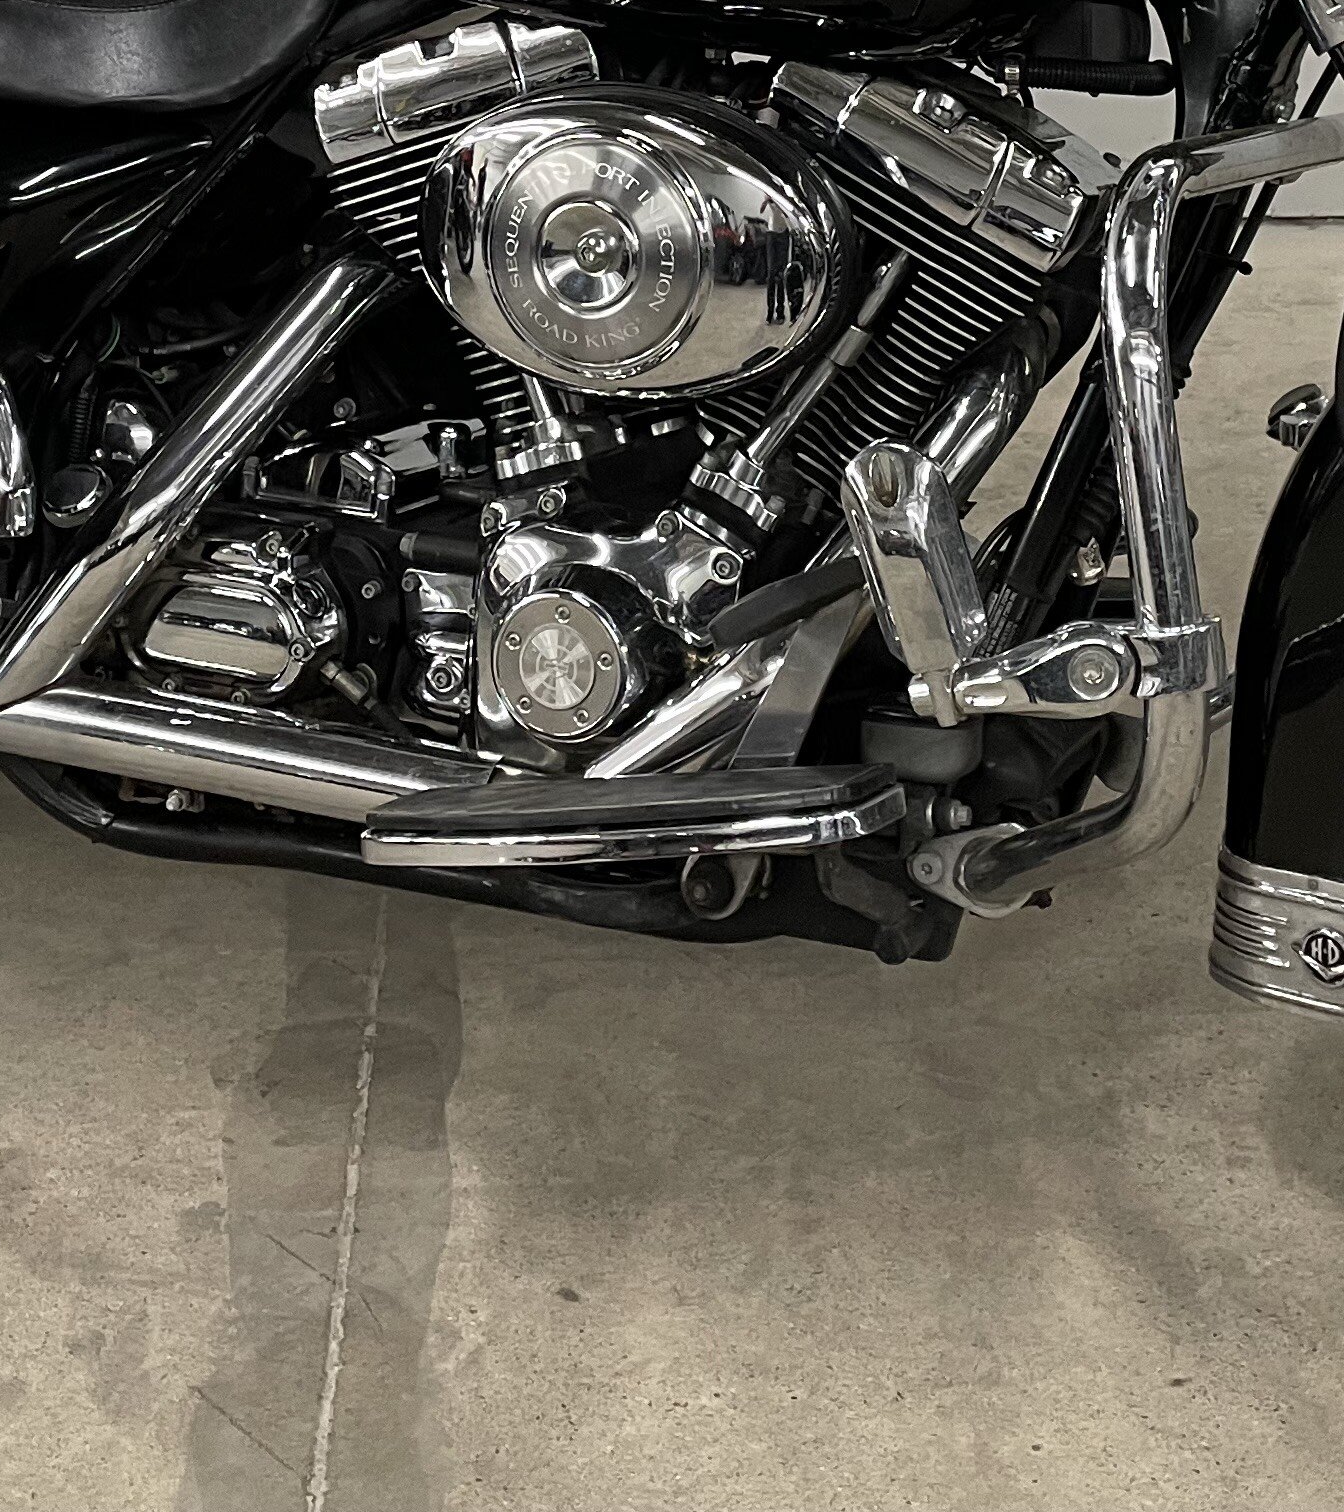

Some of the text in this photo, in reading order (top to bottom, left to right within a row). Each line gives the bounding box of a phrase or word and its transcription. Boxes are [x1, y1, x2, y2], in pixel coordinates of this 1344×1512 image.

[580, 160, 640, 191] ORT
[522, 299, 640, 348] ROAD KING
